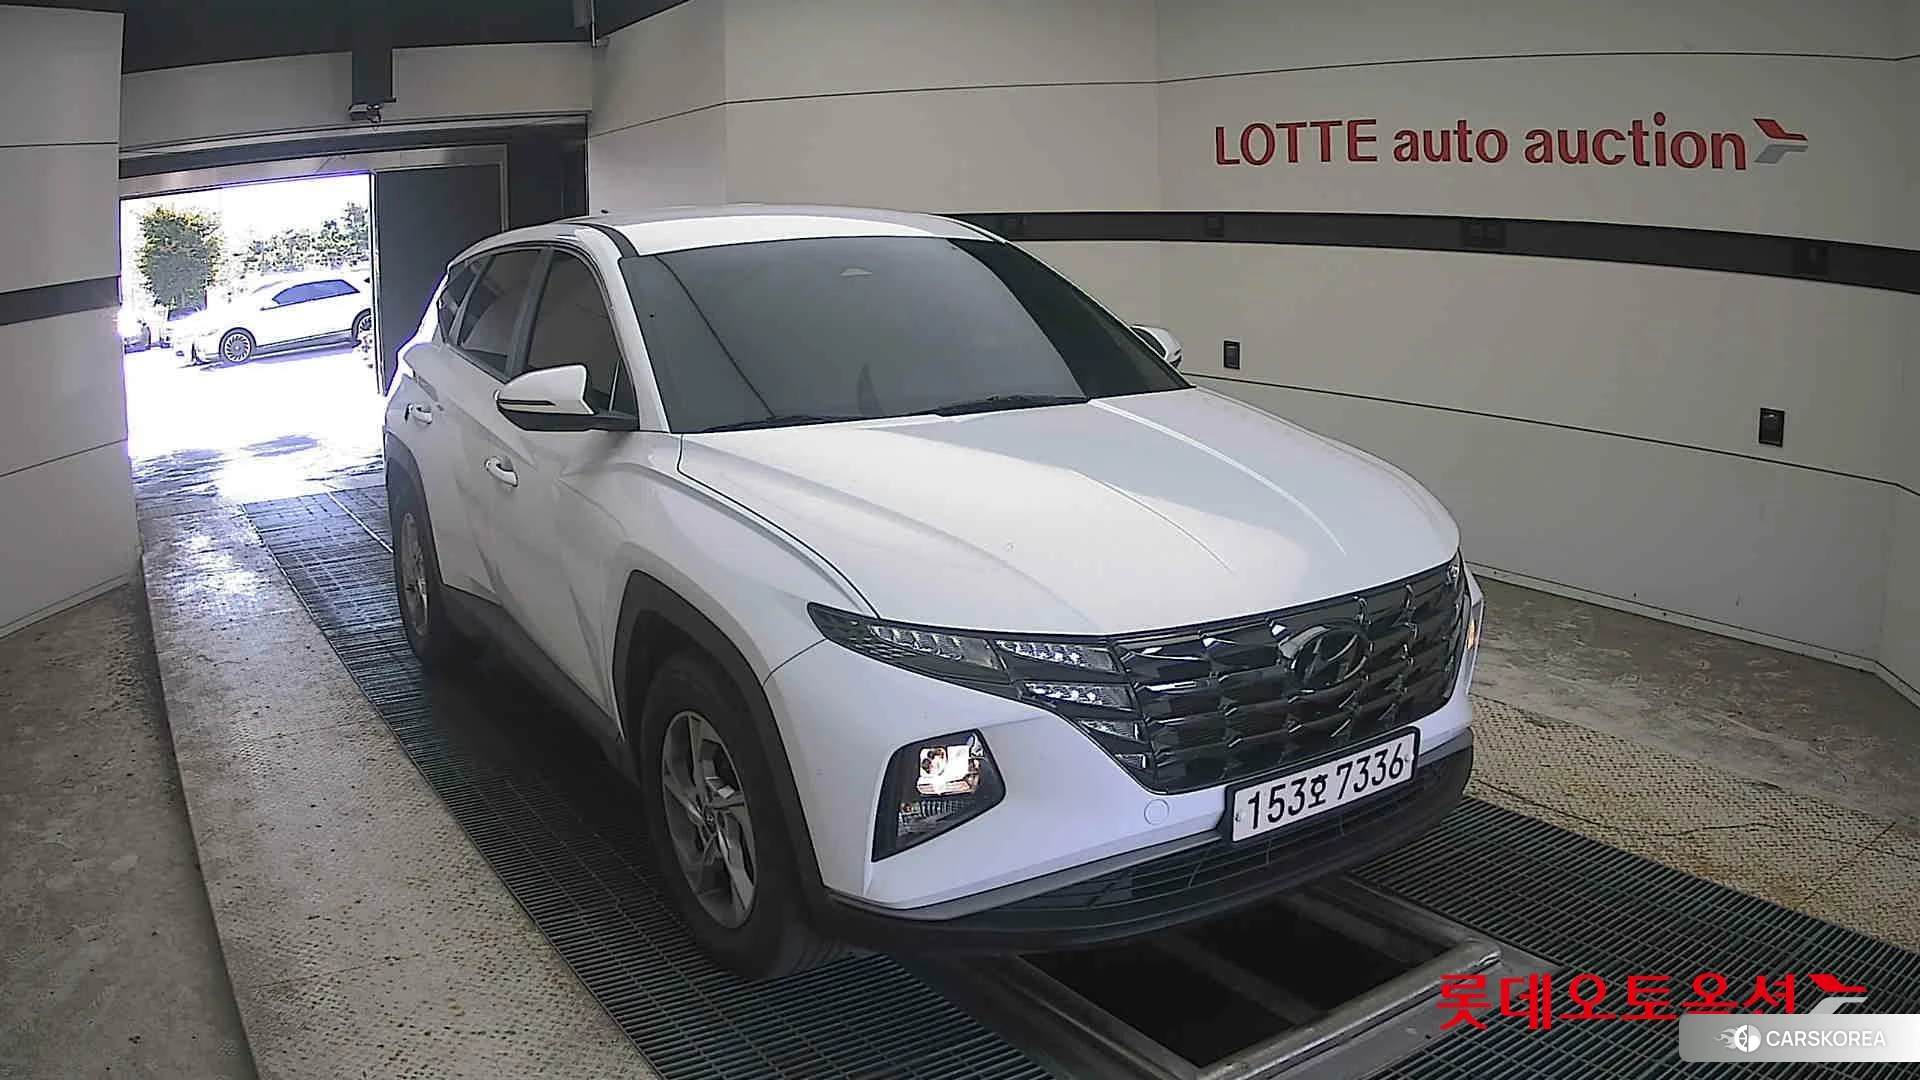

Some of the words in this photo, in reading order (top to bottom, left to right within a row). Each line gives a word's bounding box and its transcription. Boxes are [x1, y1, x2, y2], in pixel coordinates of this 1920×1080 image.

[1214, 118, 1378, 167] LOTTE
[1392, 119, 1509, 164] auto
[1524, 111, 1747, 171] auction
[1247, 773, 1329, 830] 153호
[1335, 743, 1404, 800] 7336
